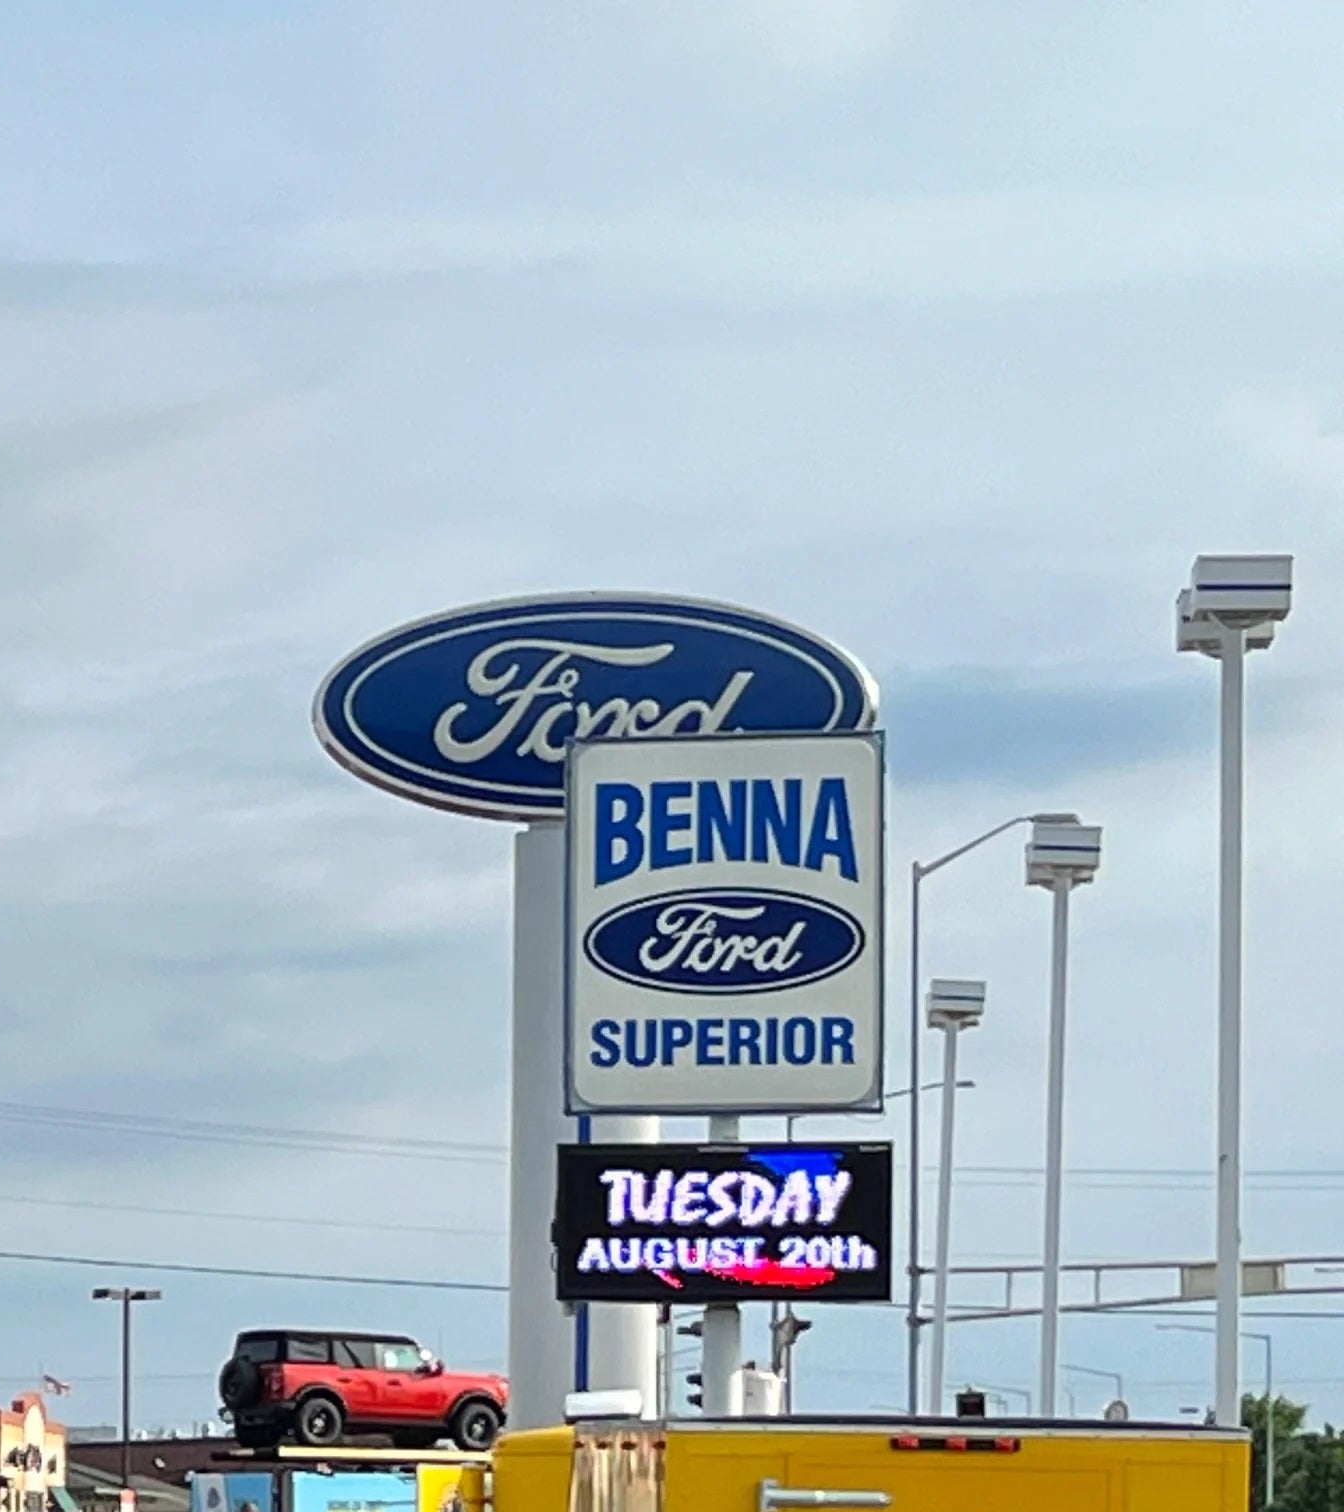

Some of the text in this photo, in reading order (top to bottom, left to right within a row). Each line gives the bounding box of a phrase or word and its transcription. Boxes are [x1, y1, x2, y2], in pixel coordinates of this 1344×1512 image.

[434, 637, 755, 764] Ford
[593, 777, 860, 889] BENNA
[638, 902, 808, 974] Ford
[589, 1016, 856, 1068] SUPERIOR
[598, 1169, 854, 1228] TUESDAY
[577, 1235, 877, 1273] AUGUST 20th
